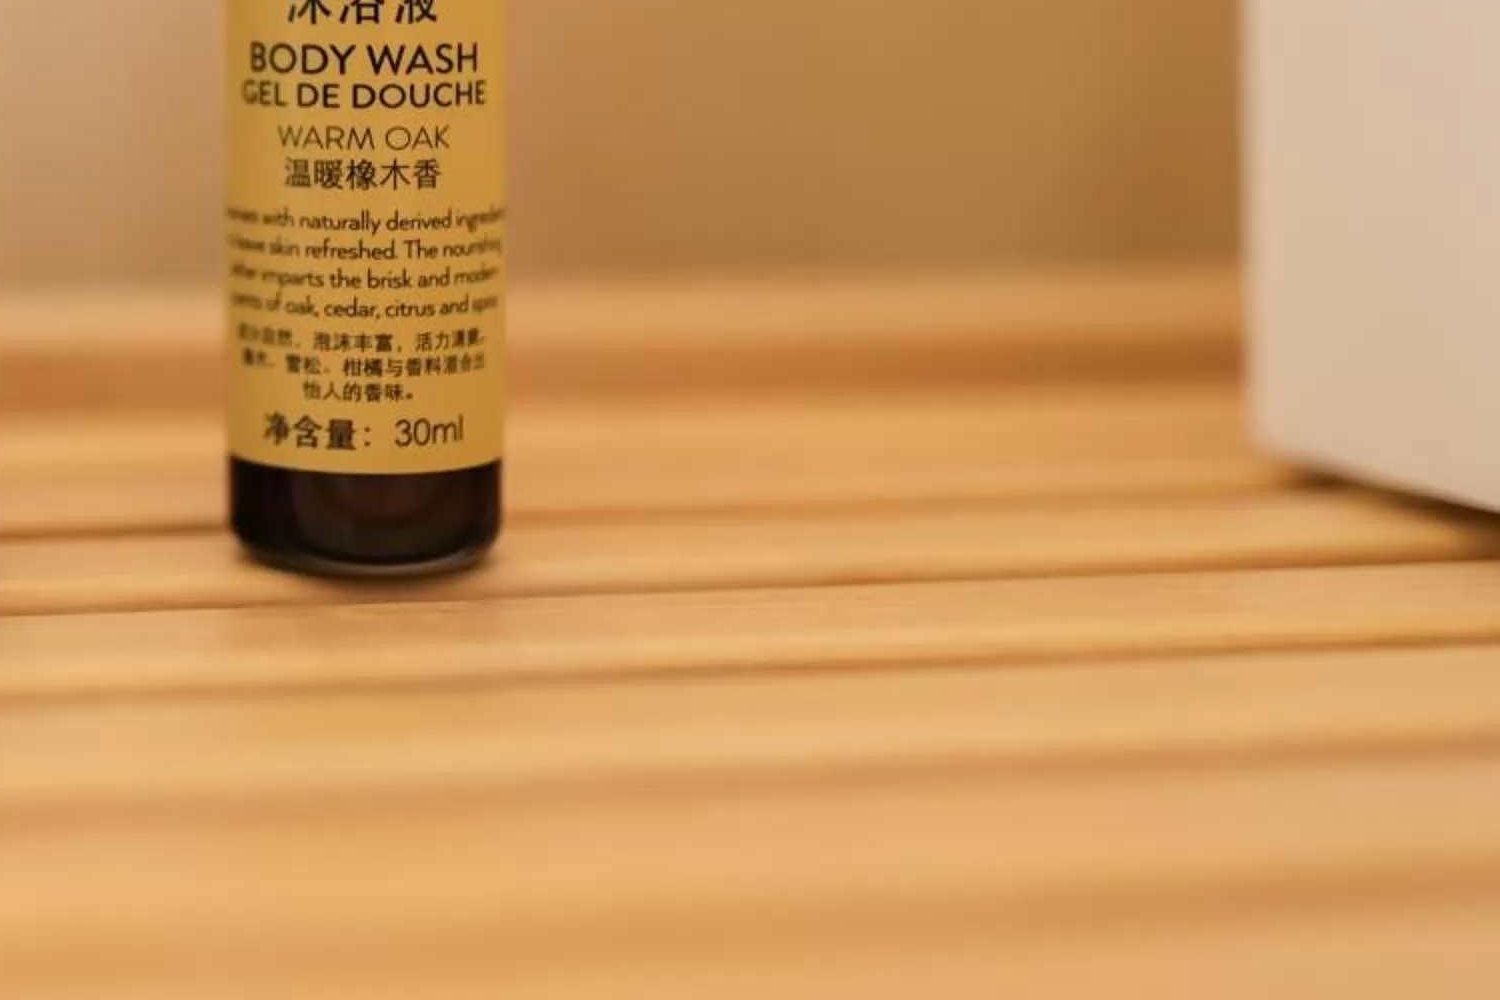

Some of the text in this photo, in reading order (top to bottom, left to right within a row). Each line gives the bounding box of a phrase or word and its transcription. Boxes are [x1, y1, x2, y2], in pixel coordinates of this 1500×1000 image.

[249, 41, 479, 76] BODY WASH
[242, 79, 487, 109] GEL DE DOUCHE
[277, 123, 451, 151] WARM OAK
[284, 157, 443, 191] 温暖橡木香
[262, 206, 295, 228] with
[299, 208, 382, 235] naturally
[385, 207, 452, 231] derived
[403, 238, 439, 259] The
[261, 269, 325, 289] imparts
[329, 267, 362, 289] the
[367, 266, 413, 290] brisk
[417, 265, 451, 288] and
[284, 294, 320, 318] oak,
[323, 296, 381, 320] cedar,
[385, 299, 437, 318] citrus
[439, 291, 469, 315] and
[395, 414, 464, 448] 30ml
